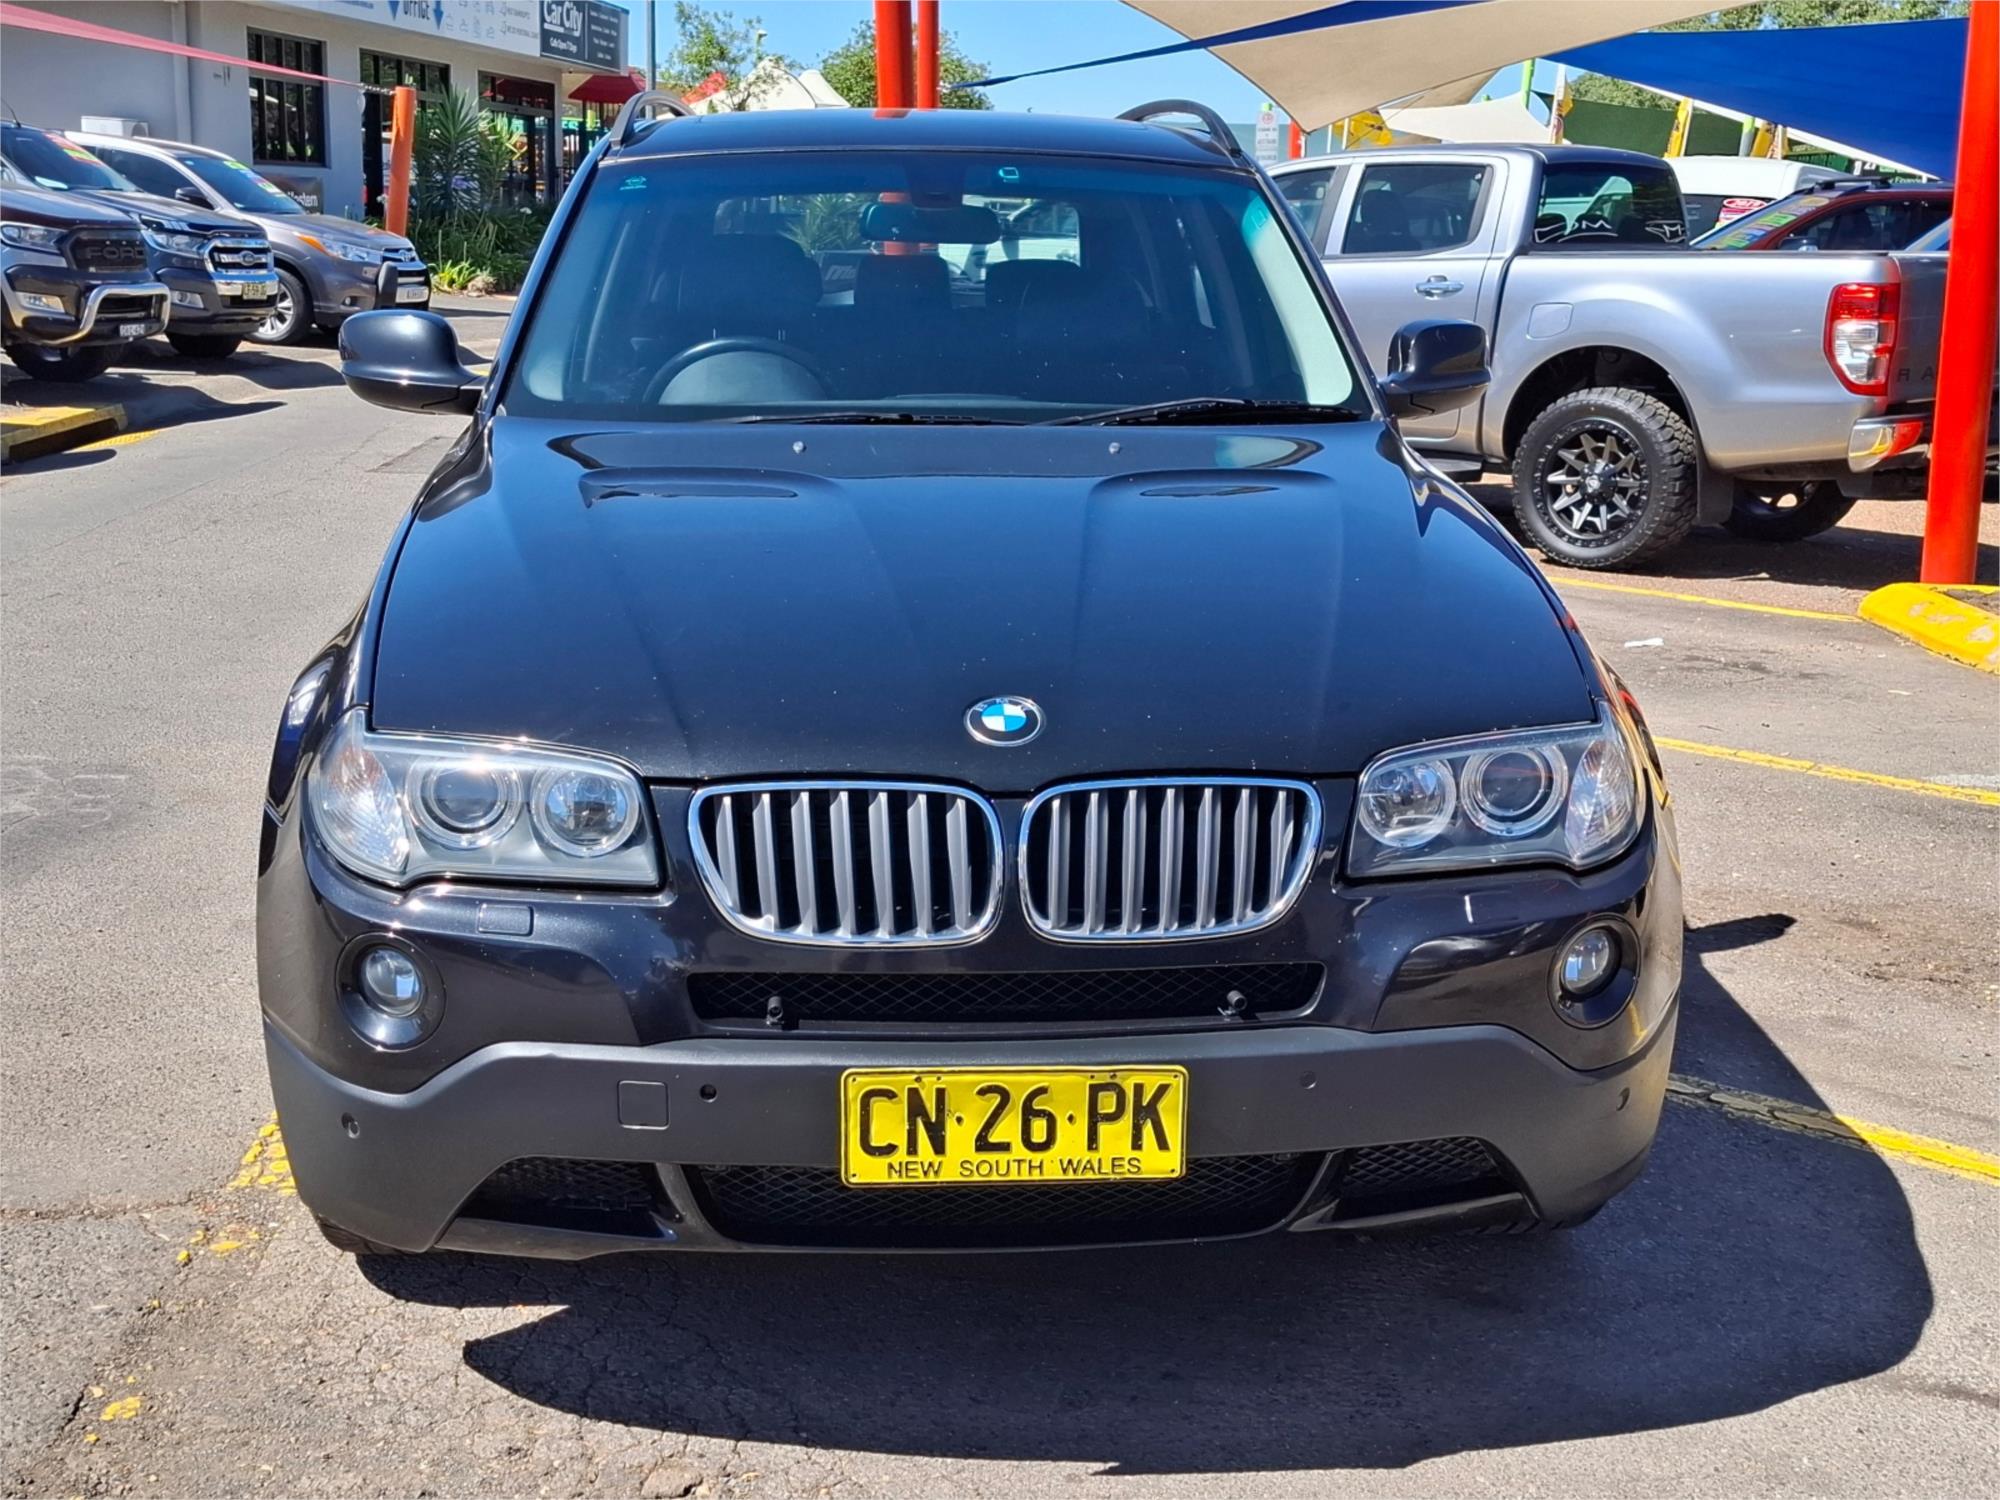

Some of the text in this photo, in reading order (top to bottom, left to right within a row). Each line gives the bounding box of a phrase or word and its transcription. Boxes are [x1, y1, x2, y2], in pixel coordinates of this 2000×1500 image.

[543, 0, 562, 25] Car
[563, 1, 583, 37] City
[887, 1156, 1143, 1179] NEW SOUTH WALES
